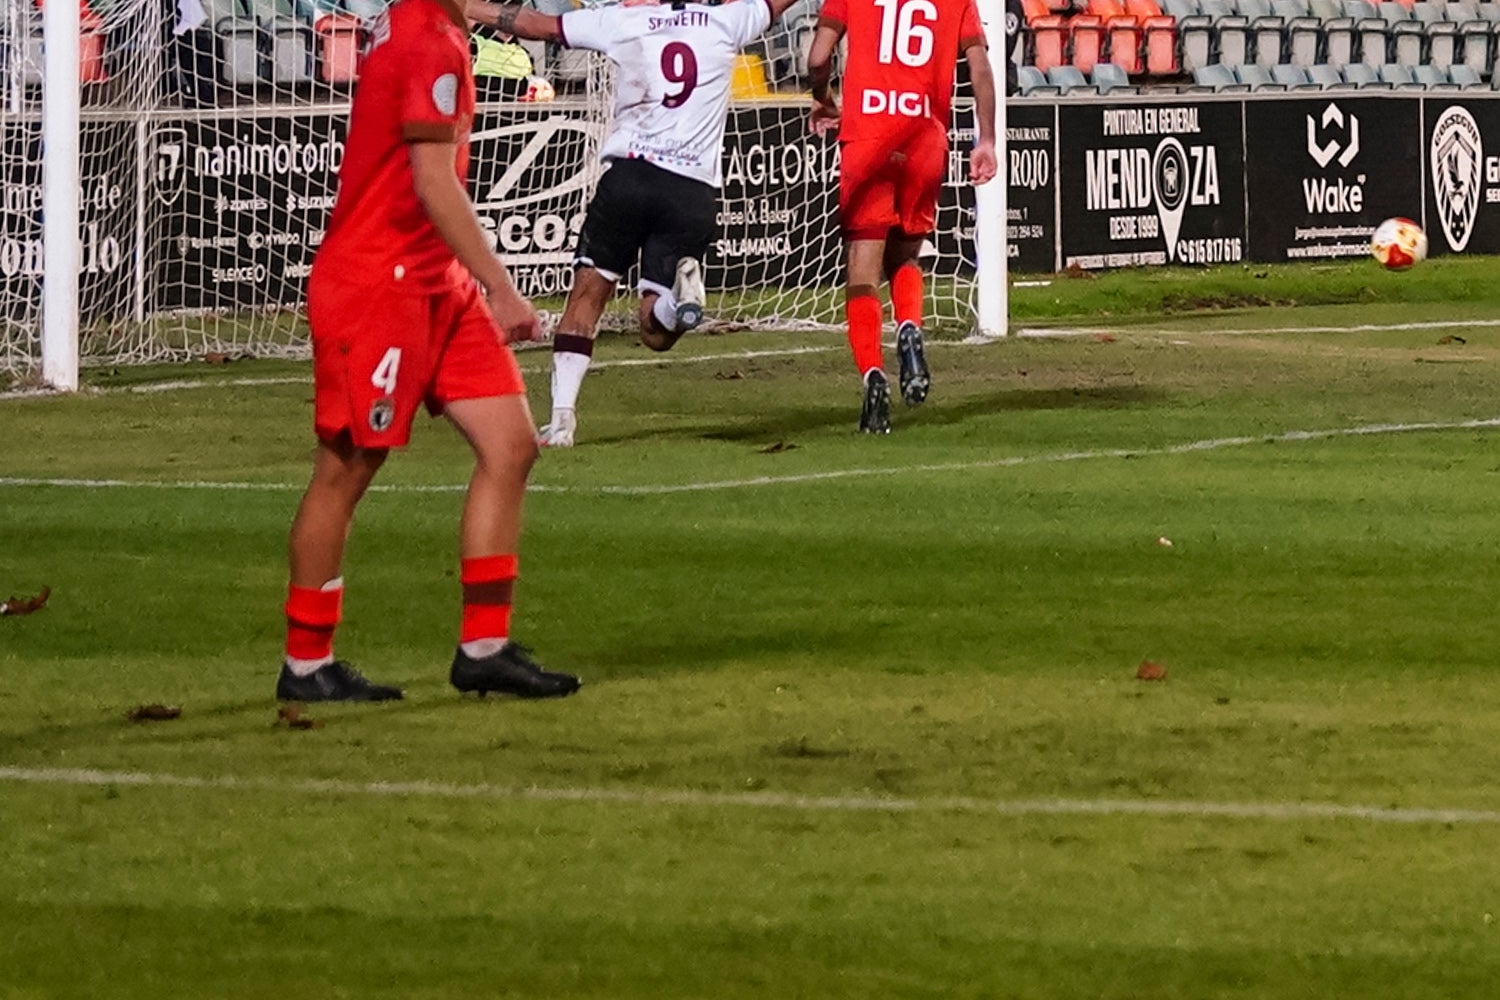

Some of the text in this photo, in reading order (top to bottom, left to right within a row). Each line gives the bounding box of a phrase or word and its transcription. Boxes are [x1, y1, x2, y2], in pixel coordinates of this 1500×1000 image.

[660, 41, 698, 109] 9
[862, 89, 931, 119] DIGI
[1006, 127, 1051, 141] STAURANTE
[1103, 107, 1201, 136] PINTURA EN GENERAL
[194, 130, 345, 177] nanimotorb
[723, 144, 842, 187] AGLORIA
[1010, 149, 1049, 190] ROJO
[298, 196, 337, 209] SUZUK
[715, 200, 744, 226] offee
[1110, 215, 1159, 240] DESDE 1999
[716, 238, 792, 258] SALAMANCA
[371, 347, 402, 395] 4
